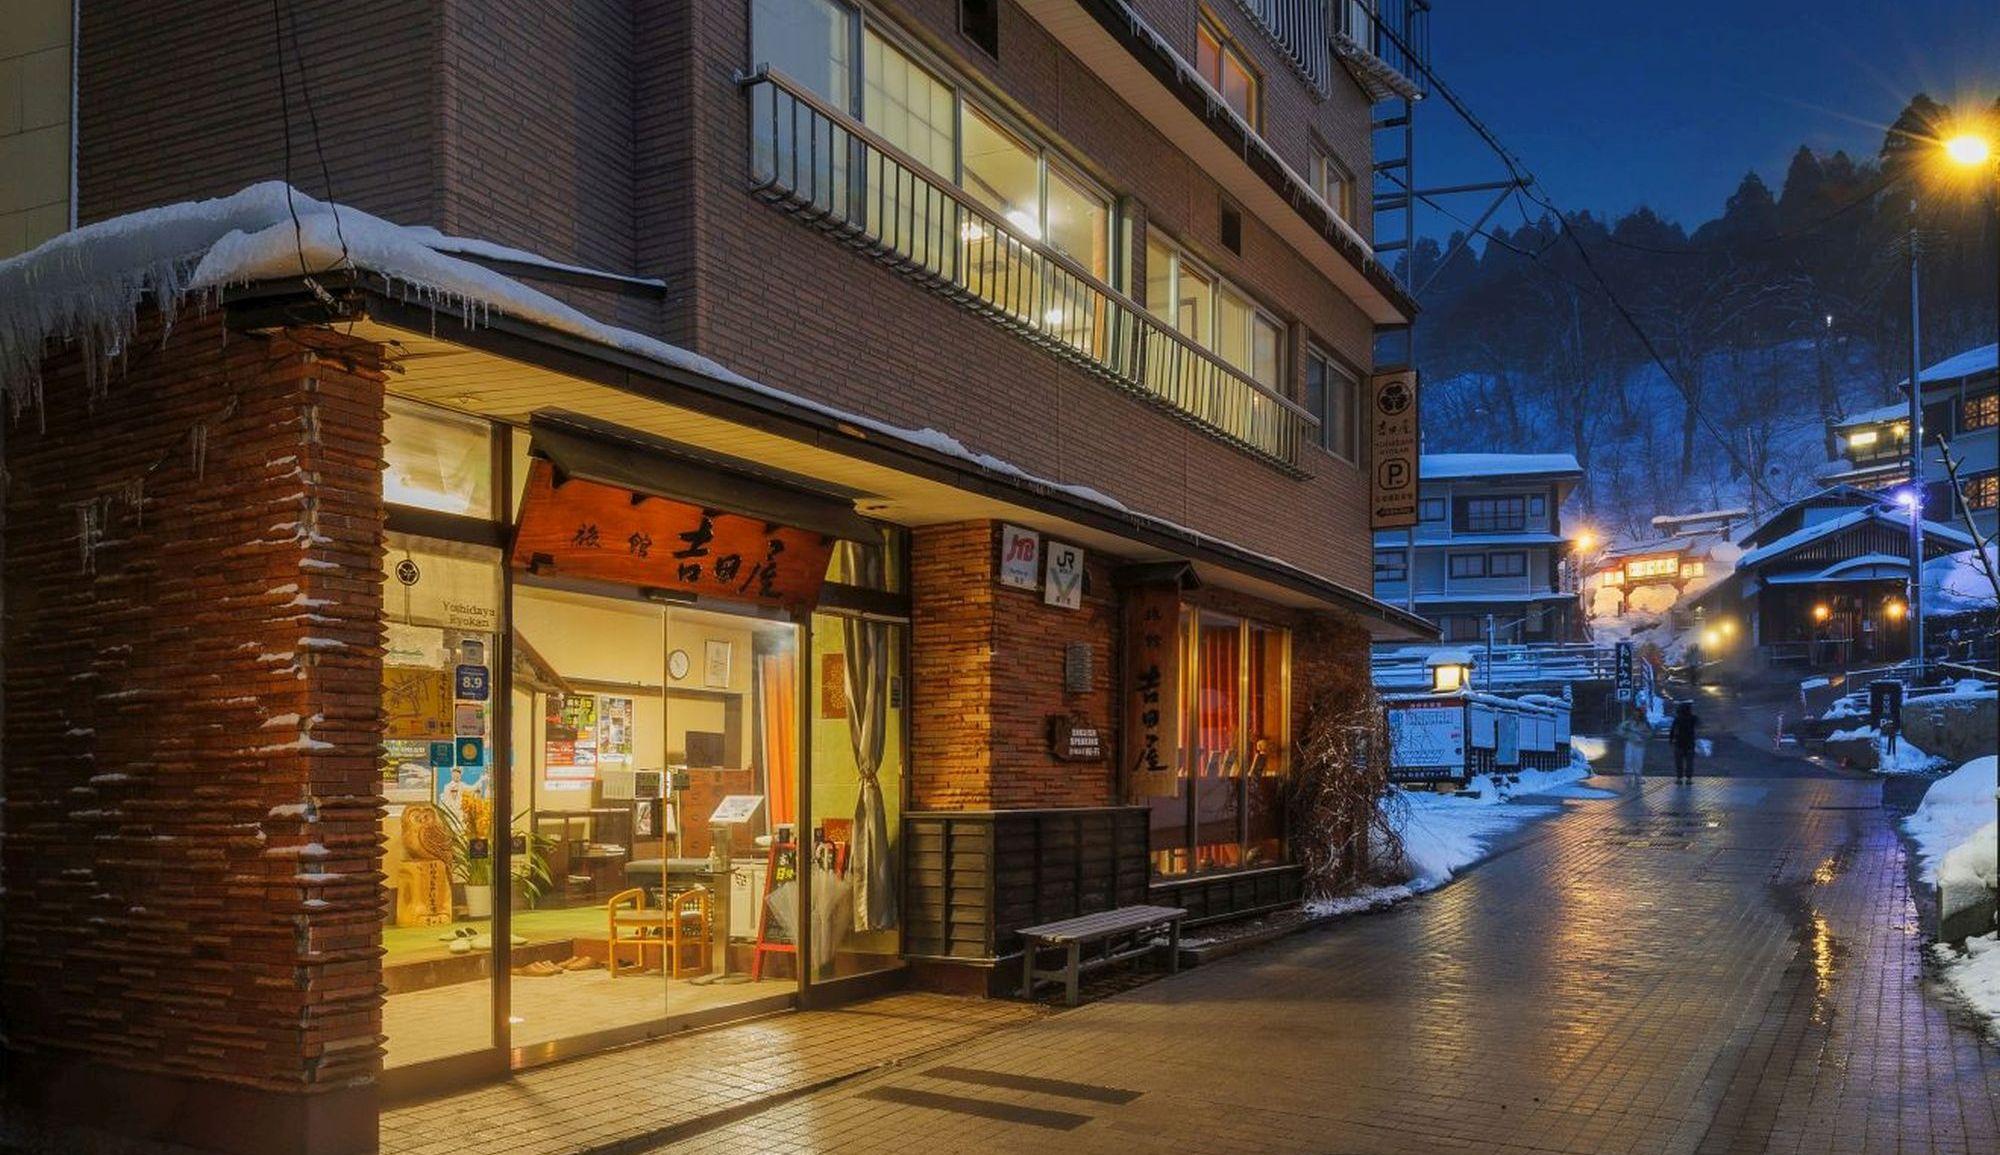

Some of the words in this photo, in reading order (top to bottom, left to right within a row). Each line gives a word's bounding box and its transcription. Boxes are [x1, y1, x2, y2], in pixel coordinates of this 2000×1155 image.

[1388, 463, 1403, 486] P
[571, 523, 653, 560] 旅館
[673, 515, 785, 599] 吉田屋
[1057, 550, 1075, 570] JR
[442, 600, 496, 617] Yoshidaya
[448, 613, 490, 628] Ryokan
[462, 676, 483, 689] 8.9
[1133, 665, 1169, 773] 吉田屋
